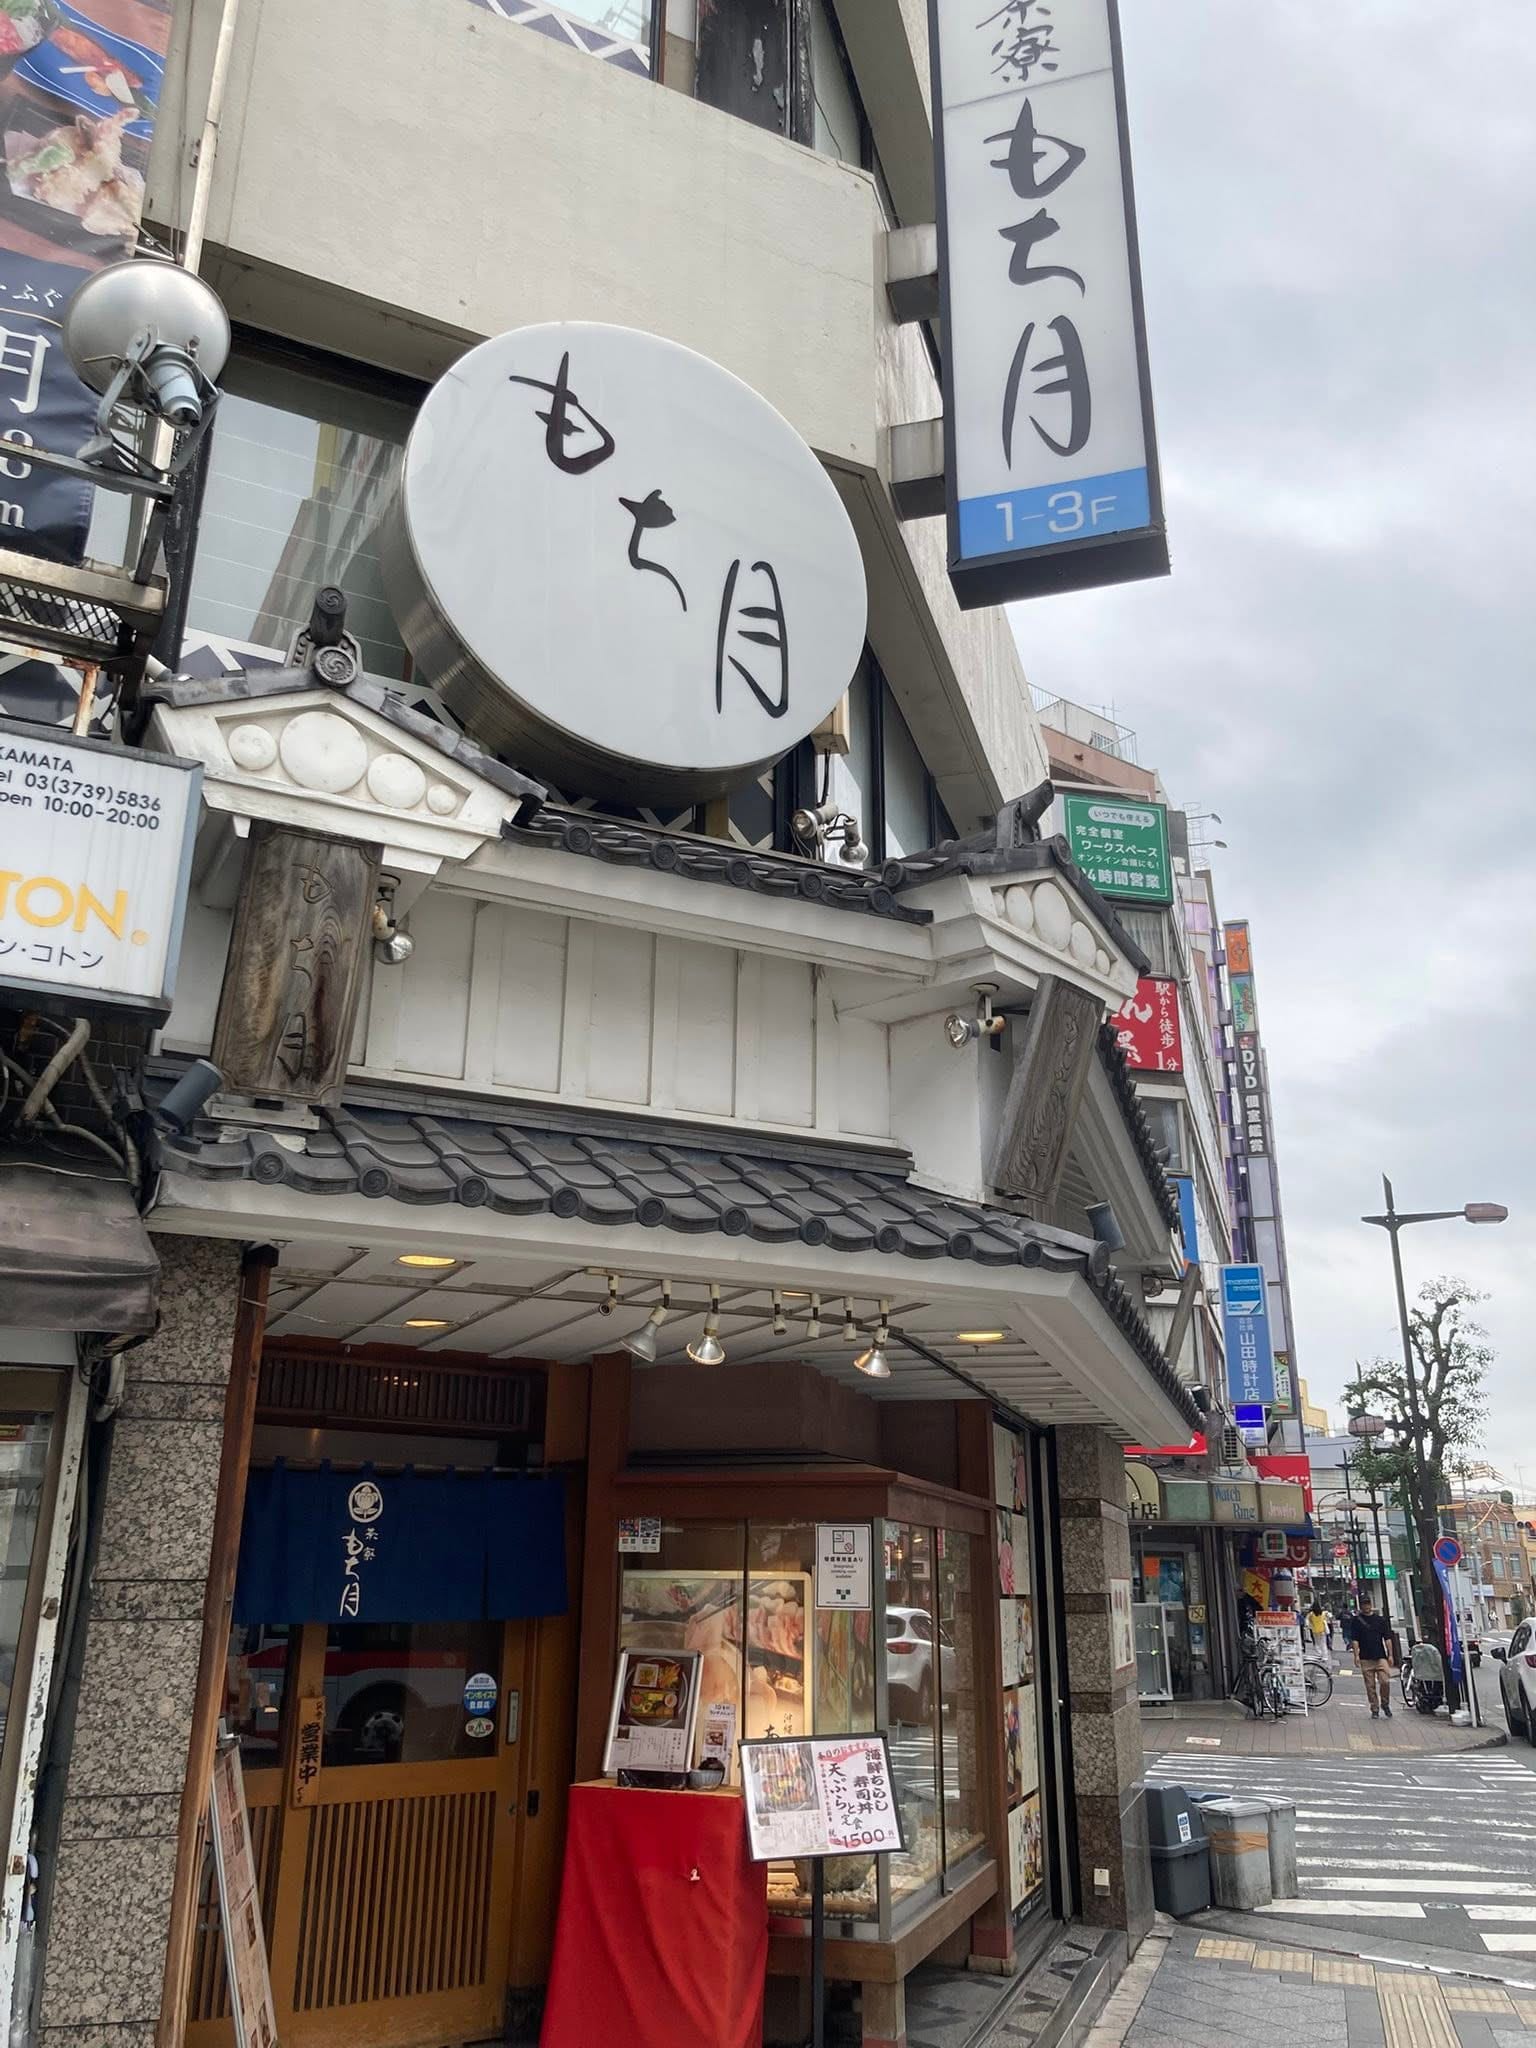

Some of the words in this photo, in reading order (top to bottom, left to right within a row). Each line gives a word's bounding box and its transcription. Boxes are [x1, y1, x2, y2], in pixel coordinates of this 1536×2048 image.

[983, 97, 1092, 471] もち月
[508, 351, 788, 719] もち月
[995, 489, 1117, 543] 1-3F
[25, 772, 162, 813] 03(3739)5836
[44, 796, 160, 831] 10:00-20:00
[1075, 825, 1124, 840] 完全個室
[1081, 840, 1158, 858] ワークスペース
[1241, 1050, 1257, 1090] DVD
[1240, 1333, 1260, 1401] 山田時計店
[1214, 1486, 1241, 1503] Watch
[1232, 1505, 1256, 1521] Ring
[341, 1527, 364, 1617] もち月
[299, 1722, 321, 1785] 営業中
